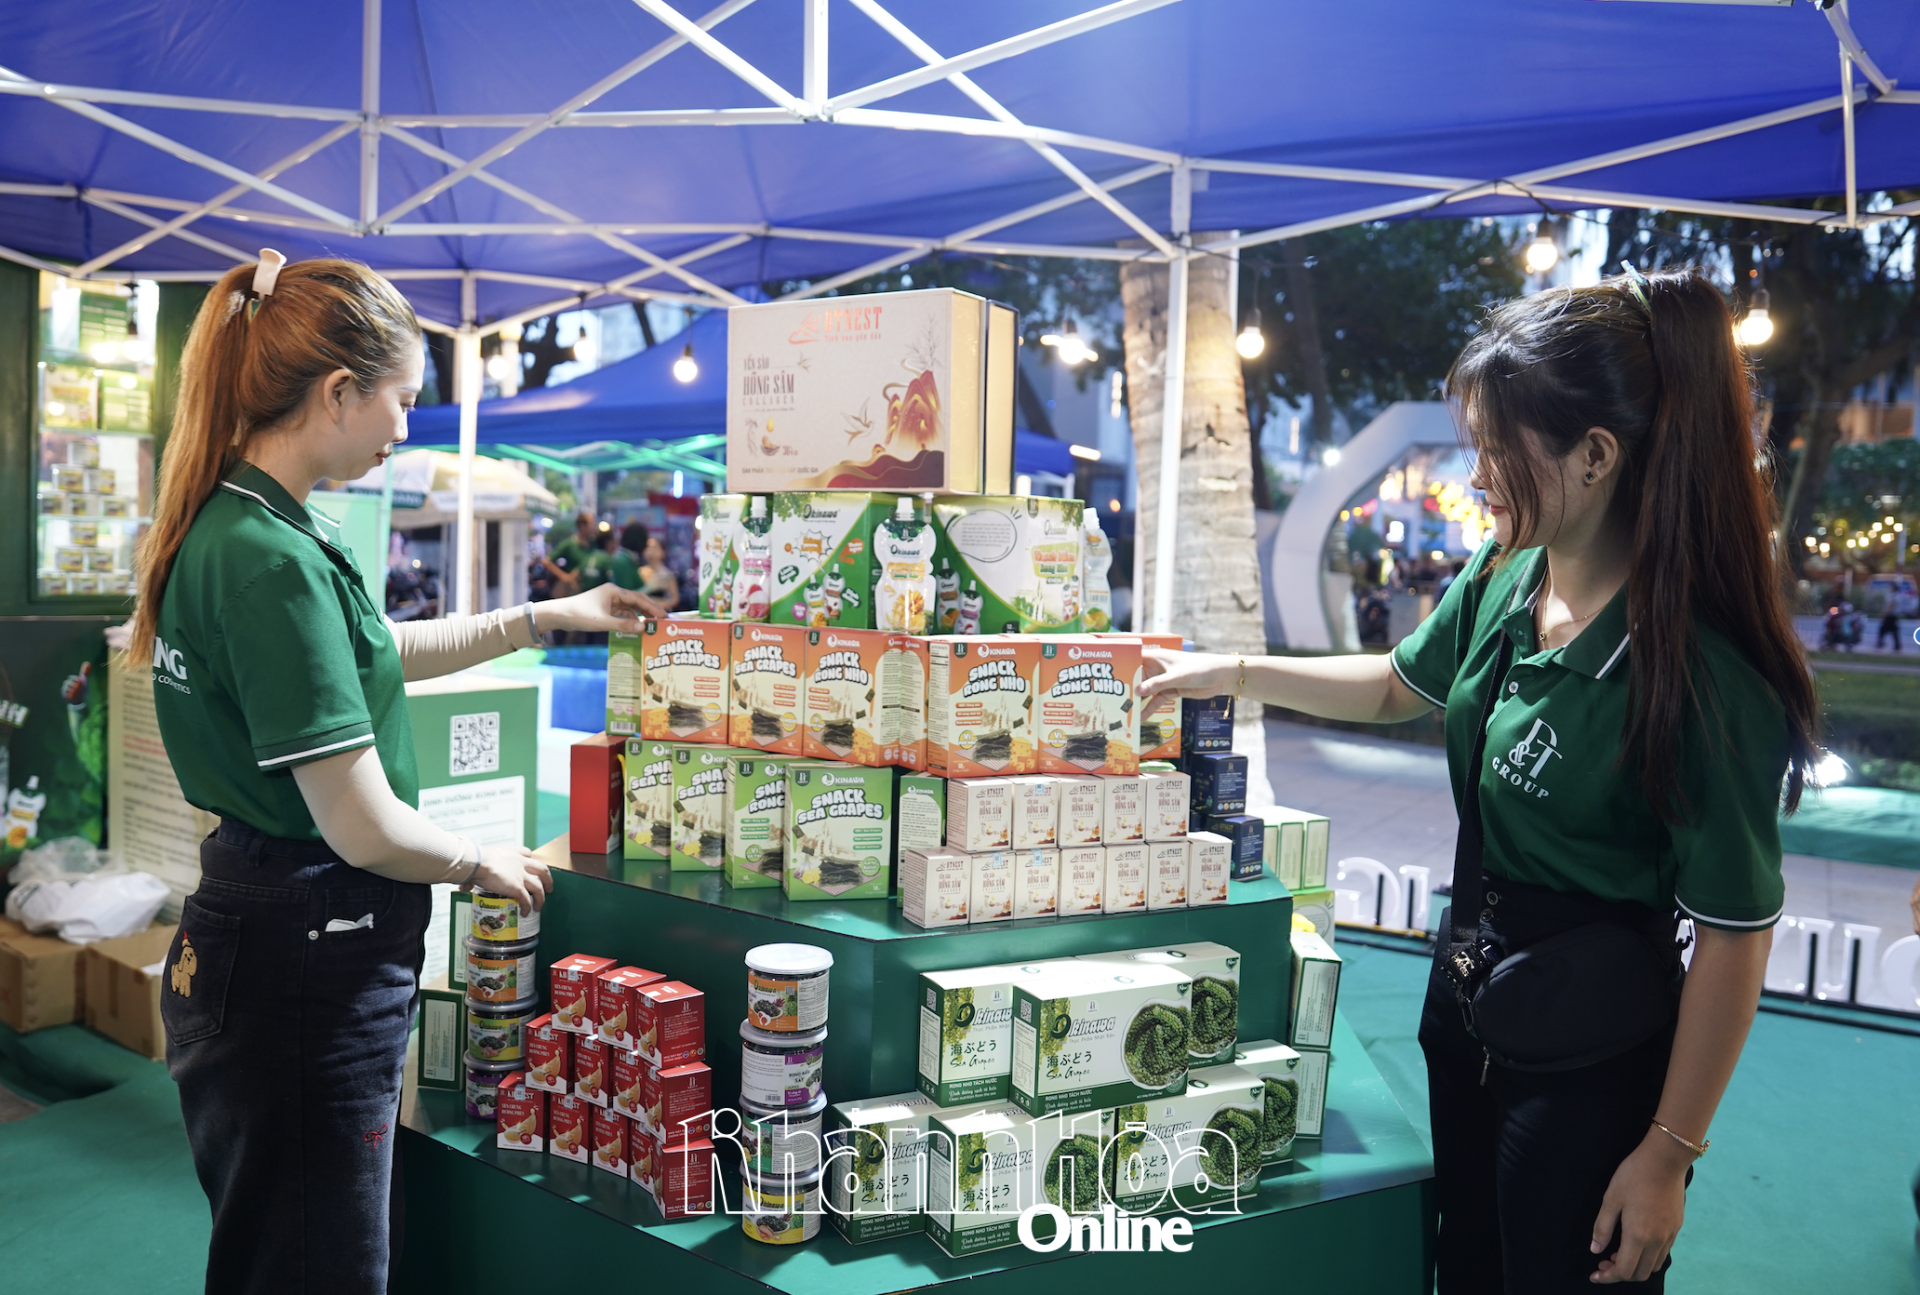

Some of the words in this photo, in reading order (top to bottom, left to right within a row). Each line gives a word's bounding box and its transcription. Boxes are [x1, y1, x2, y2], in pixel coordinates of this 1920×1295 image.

[743, 371, 770, 396] HỒNG
[773, 369, 794, 395] SÂM
[152, 635, 188, 680] NG
[657, 639, 705, 656] SNACK
[744, 644, 783, 662] SNACK
[646, 655, 671, 670] SEA
[673, 653, 721, 670] GRAPES
[734, 661, 754, 676] SEA
[756, 659, 797, 678] GRAPES
[819, 650, 861, 669] SNACK
[814, 666, 843, 684] RONG
[844, 667, 868, 686] NHO
[968, 659, 1018, 682] SNACK
[1057, 662, 1113, 683] SNACK
[157, 674, 191, 695] COSMETICS
[962, 678, 998, 698] RONG
[998, 675, 1026, 693] NHO
[1051, 680, 1091, 698] RONG
[1093, 678, 1125, 696] NHO
[643, 759, 672, 777] SNA
[1491, 756, 1550, 799] GROUP
[630, 775, 657, 791] SEA
[678, 784, 705, 800] SEA
[754, 779, 784, 800] SNA
[811, 788, 866, 810] SNACK
[797, 807, 828, 825] SEA
[829, 802, 884, 820] GRAPES
[954, 1002, 1012, 1027] Okinaw
[950, 1039, 997, 1056] 海ぶどう
[1046, 1050, 1092, 1068] 海ぶどう
